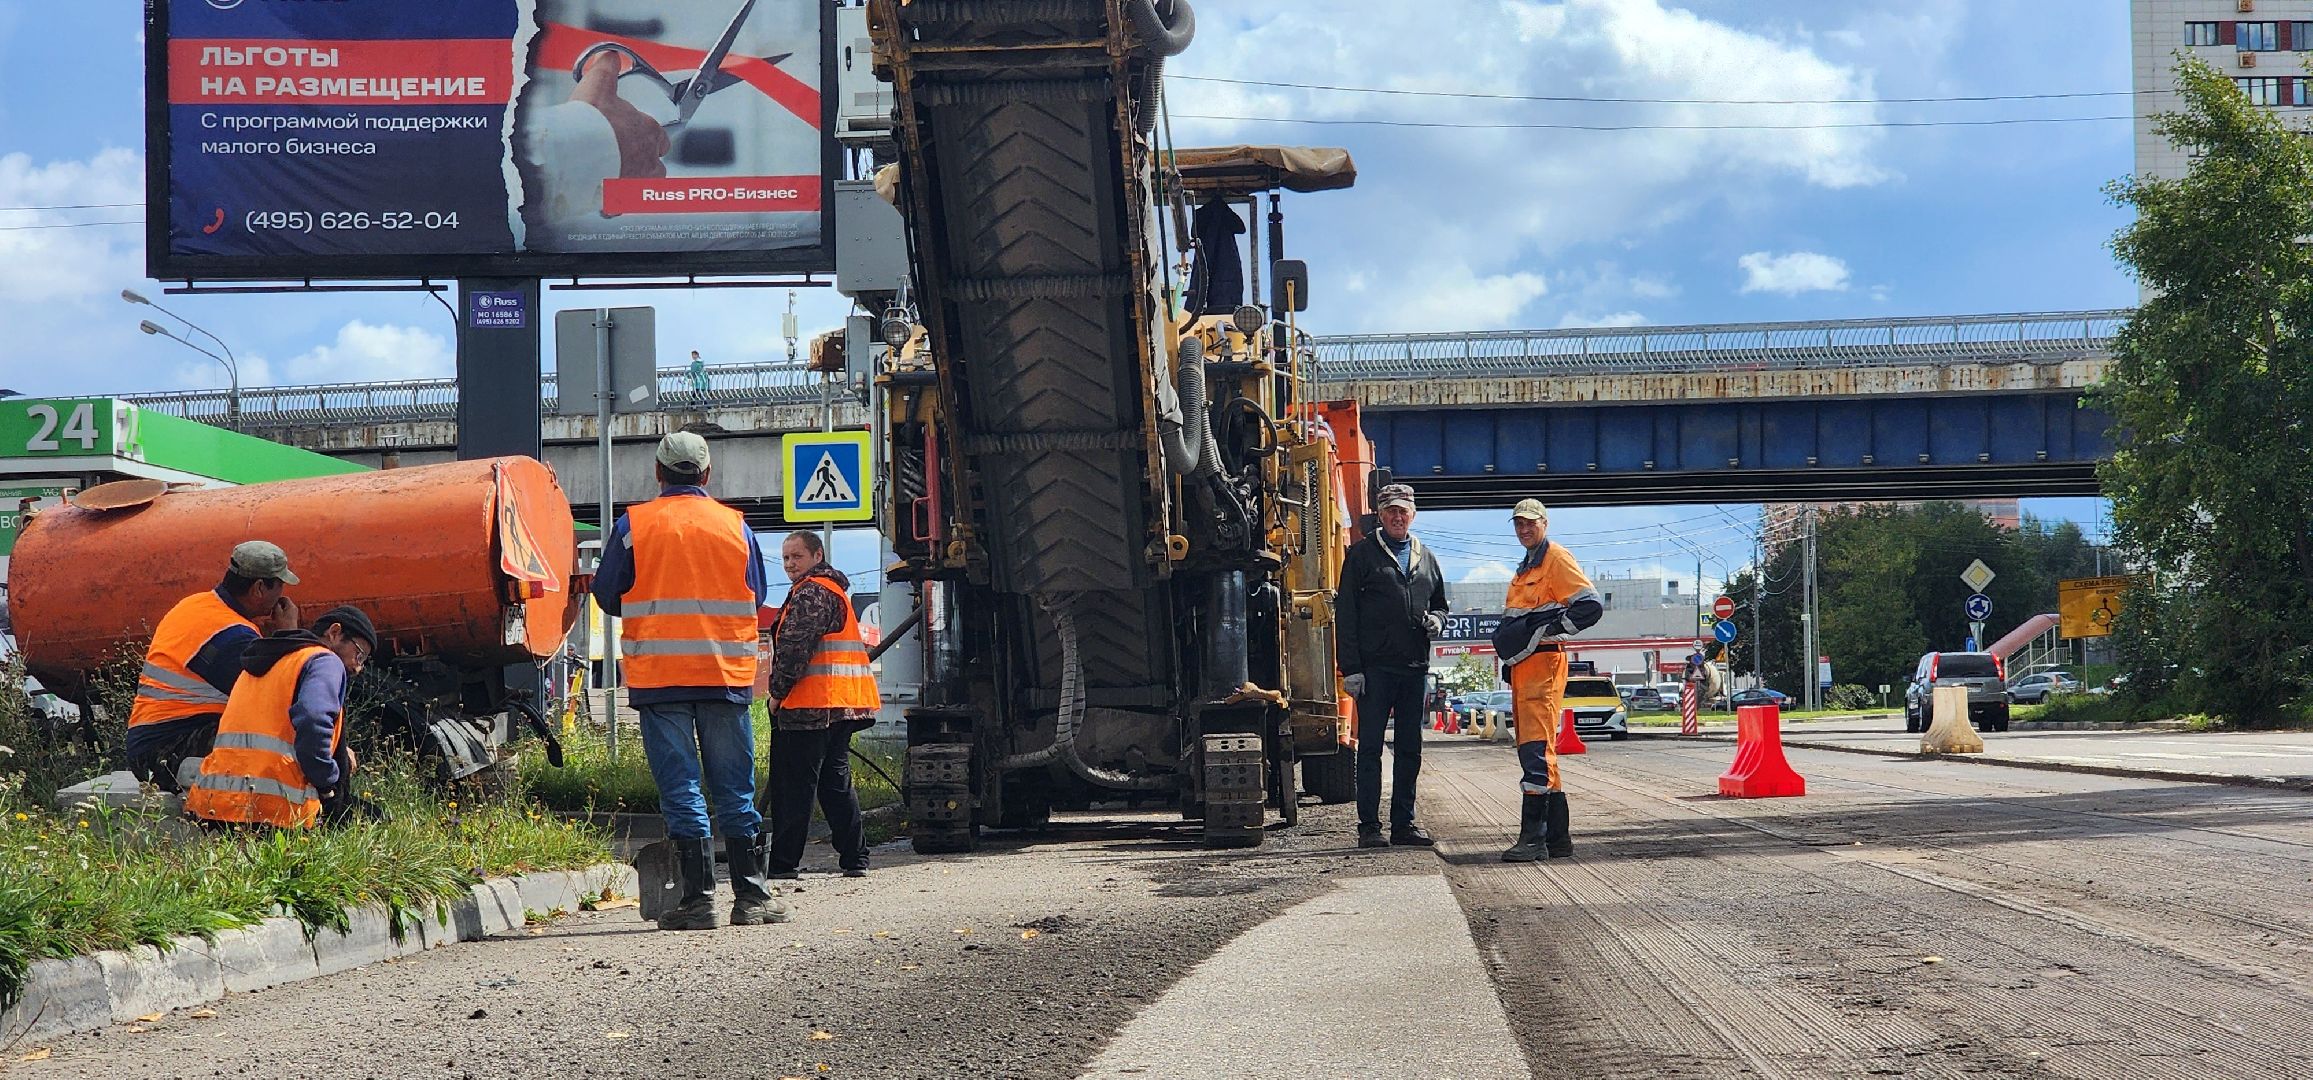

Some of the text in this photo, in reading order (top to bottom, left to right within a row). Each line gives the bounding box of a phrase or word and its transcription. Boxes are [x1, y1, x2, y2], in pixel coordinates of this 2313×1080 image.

[200, 47, 338, 67] ЛЬГОТЫ
[201, 77, 486, 100] НА РАЗМЕЩЕНИЕ
[201, 113, 487, 132] С программой поддержки
[201, 138, 376, 155] малого бизнеса
[642, 187, 798, 201] Russ PRO-Бизнес
[245, 210, 460, 233] (495) 626-52-04
[494, 297, 517, 306] Russ
[26, 403, 99, 451] 24
[1446, 617, 1471, 629] OR
[1442, 629, 1471, 638] ERT
